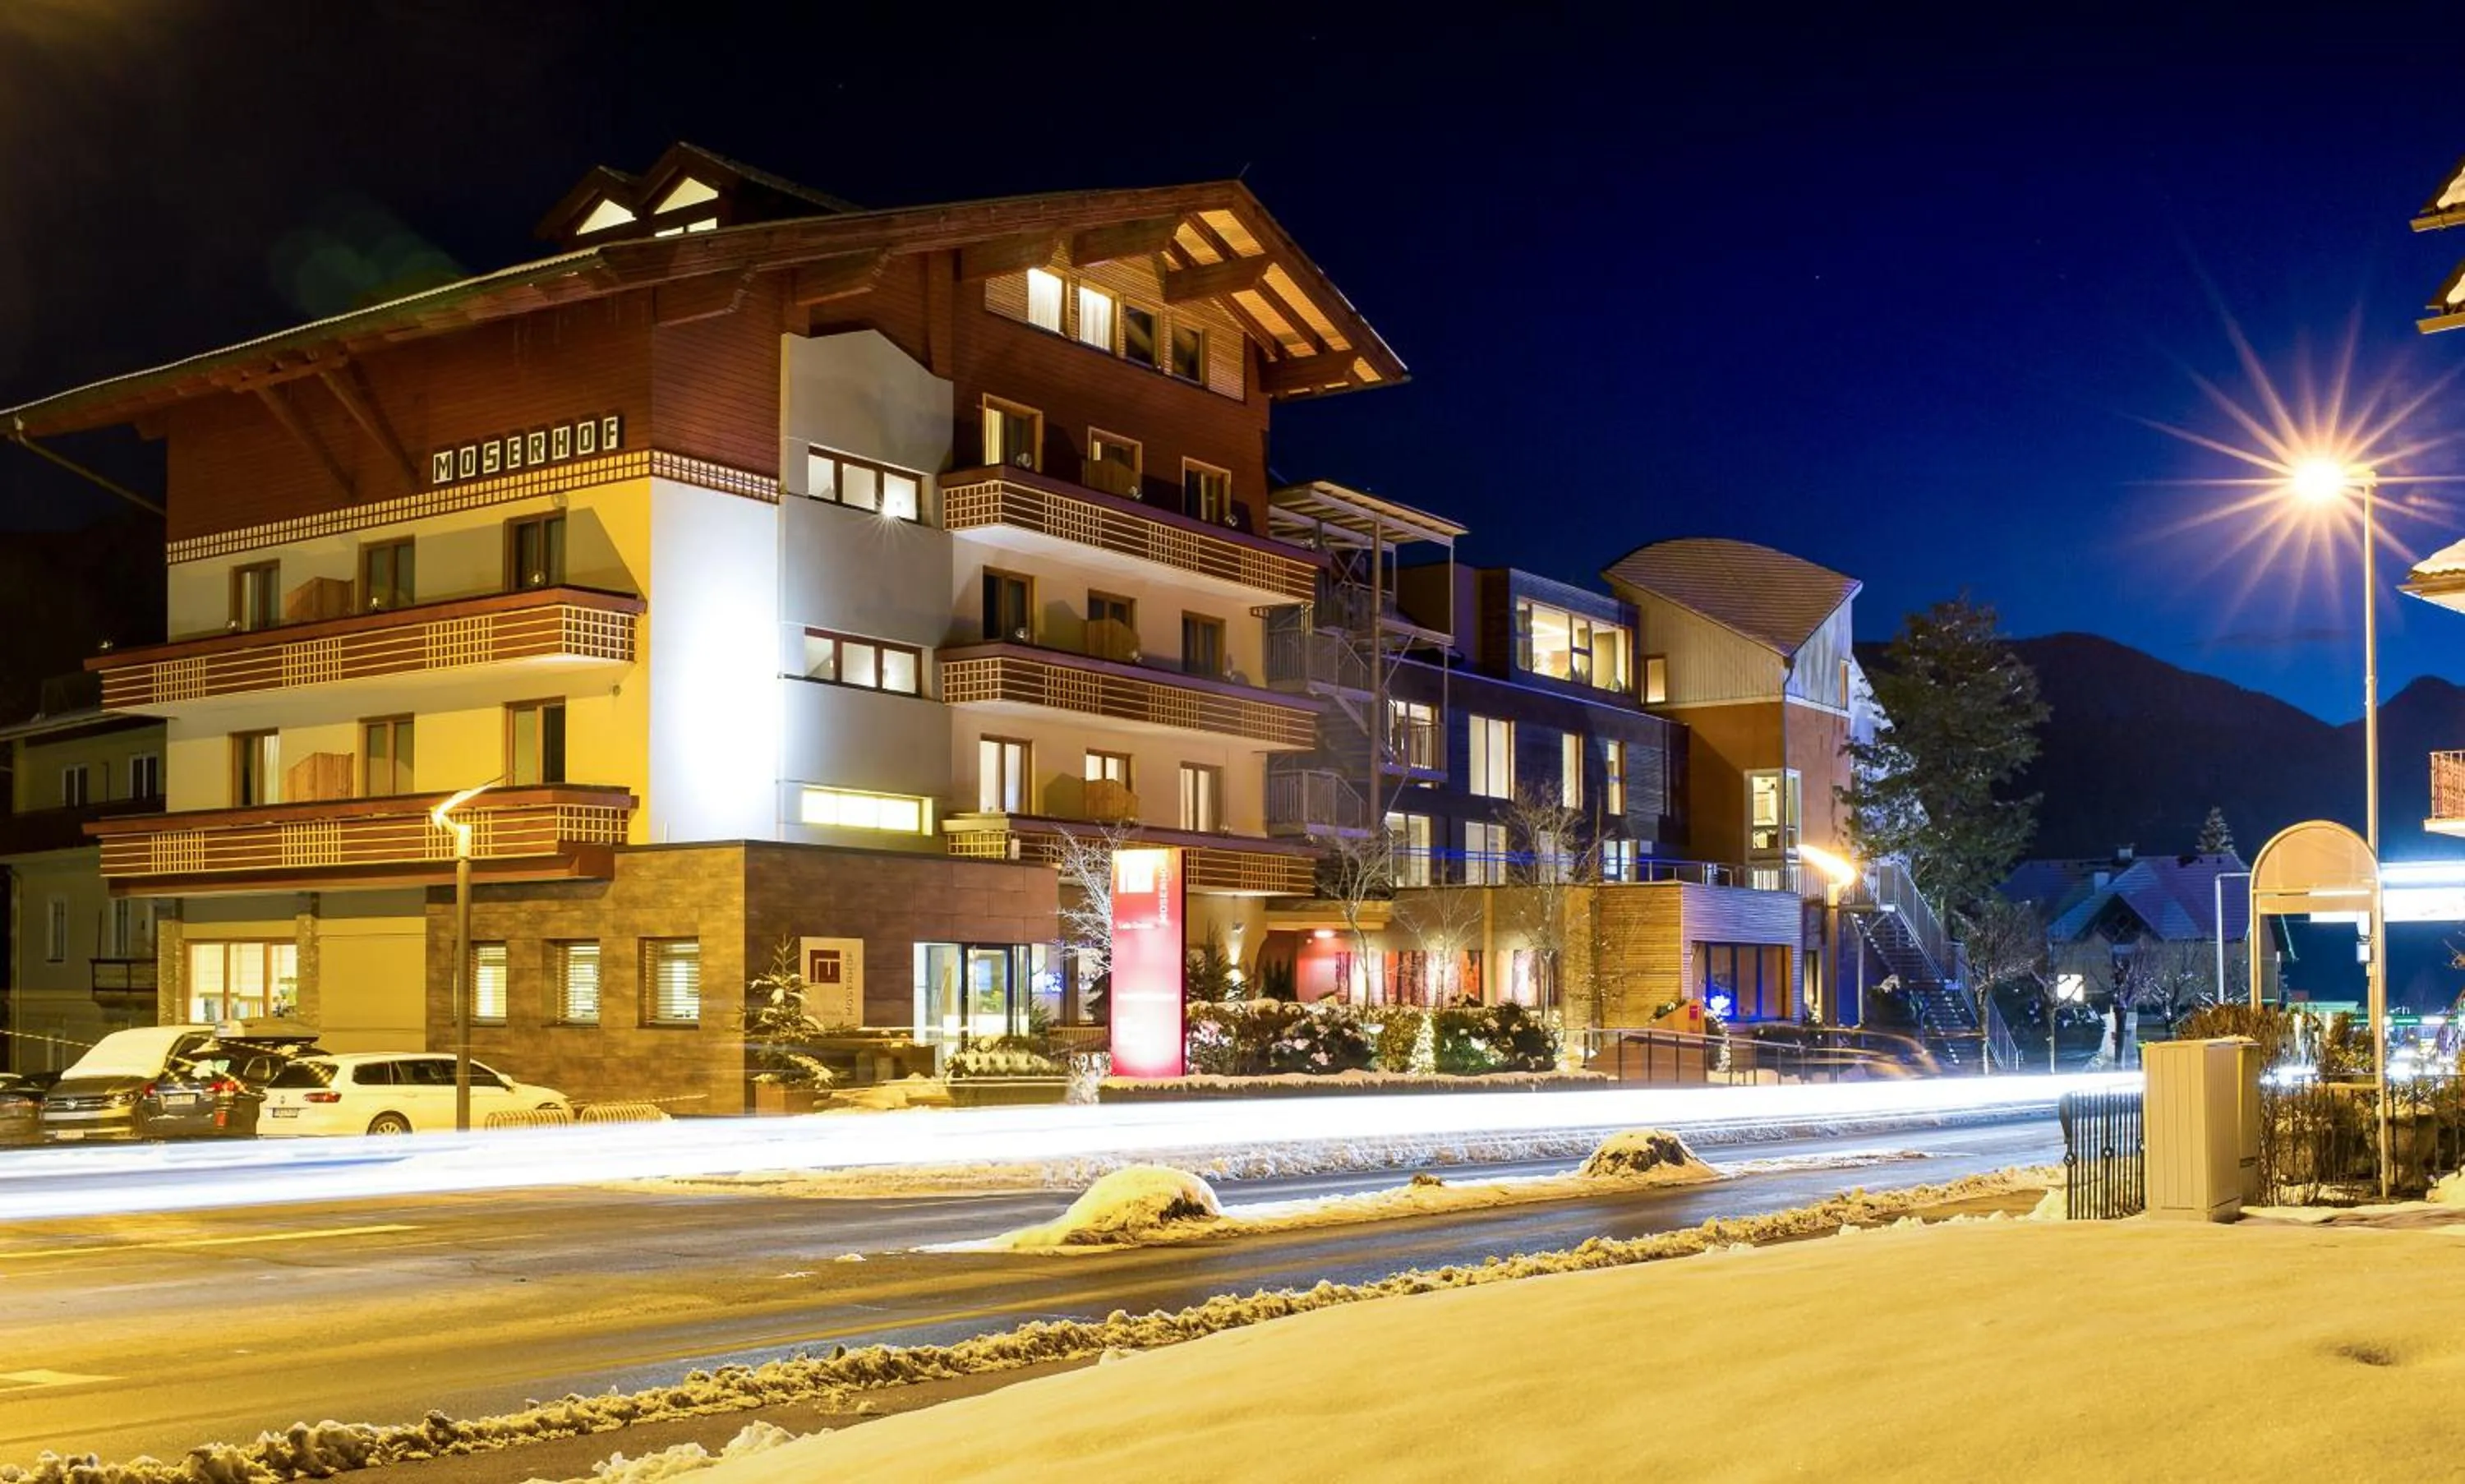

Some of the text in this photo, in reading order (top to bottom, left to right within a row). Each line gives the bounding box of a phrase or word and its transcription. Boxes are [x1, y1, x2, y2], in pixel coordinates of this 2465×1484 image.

[433, 416, 619, 484] MOSERHOF
[1159, 860, 1168, 924] MOSERHO
[845, 951, 855, 1016] MOSERHOF
